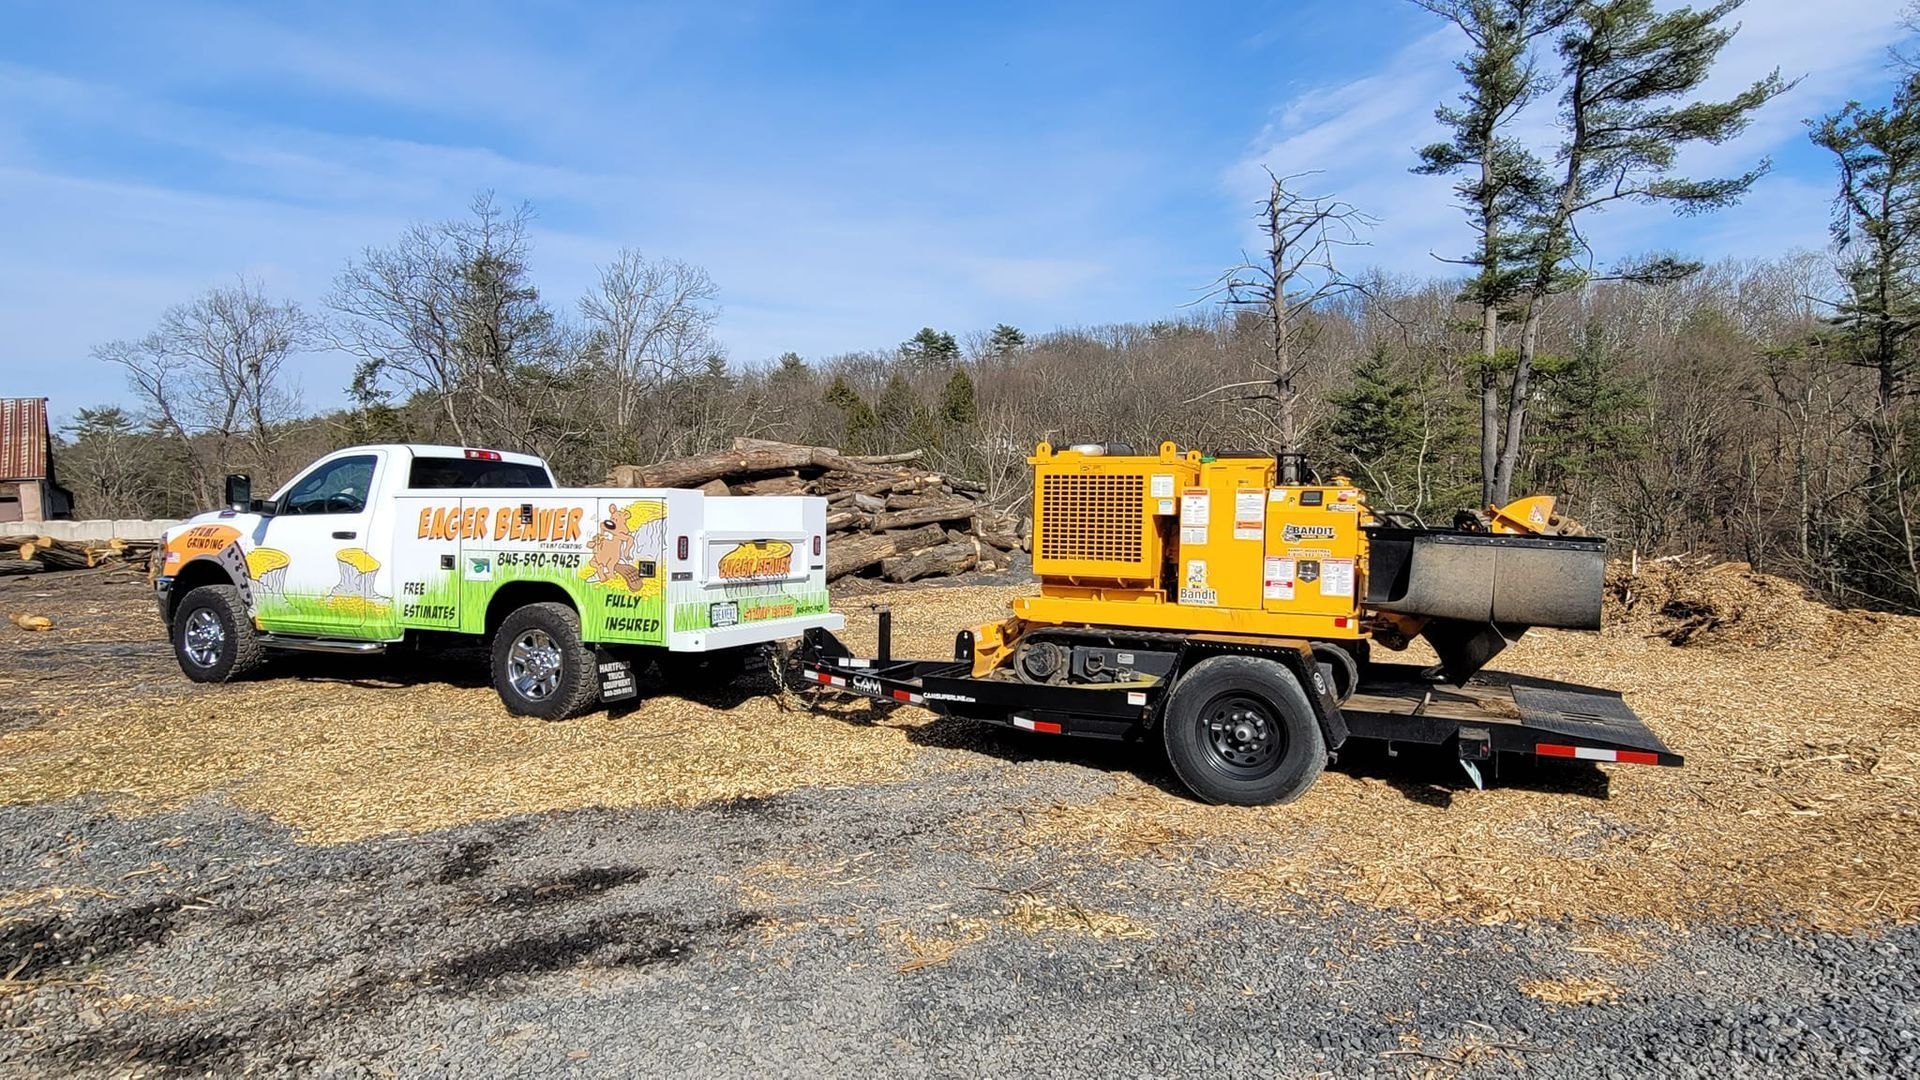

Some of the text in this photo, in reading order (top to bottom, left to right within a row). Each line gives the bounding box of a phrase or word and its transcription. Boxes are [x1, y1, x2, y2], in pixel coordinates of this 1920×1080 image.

[418, 506, 584, 542] EAGER BEAVER
[1293, 526, 1334, 535] BANDIT
[188, 527, 219, 537] STUMP
[186, 538, 223, 550] GRINDING
[497, 552, 580, 569] 845-590-9425
[719, 556, 791, 579] EAGER BEAVER
[403, 582, 425, 595] FREE
[1180, 588, 1216, 600] Bandit
[605, 594, 642, 609] FULLY
[403, 604, 455, 620] ESTIMATES
[605, 617, 660, 632] INSURED
[607, 671, 625, 681] TRUCK
[853, 676, 882, 696] CAM
